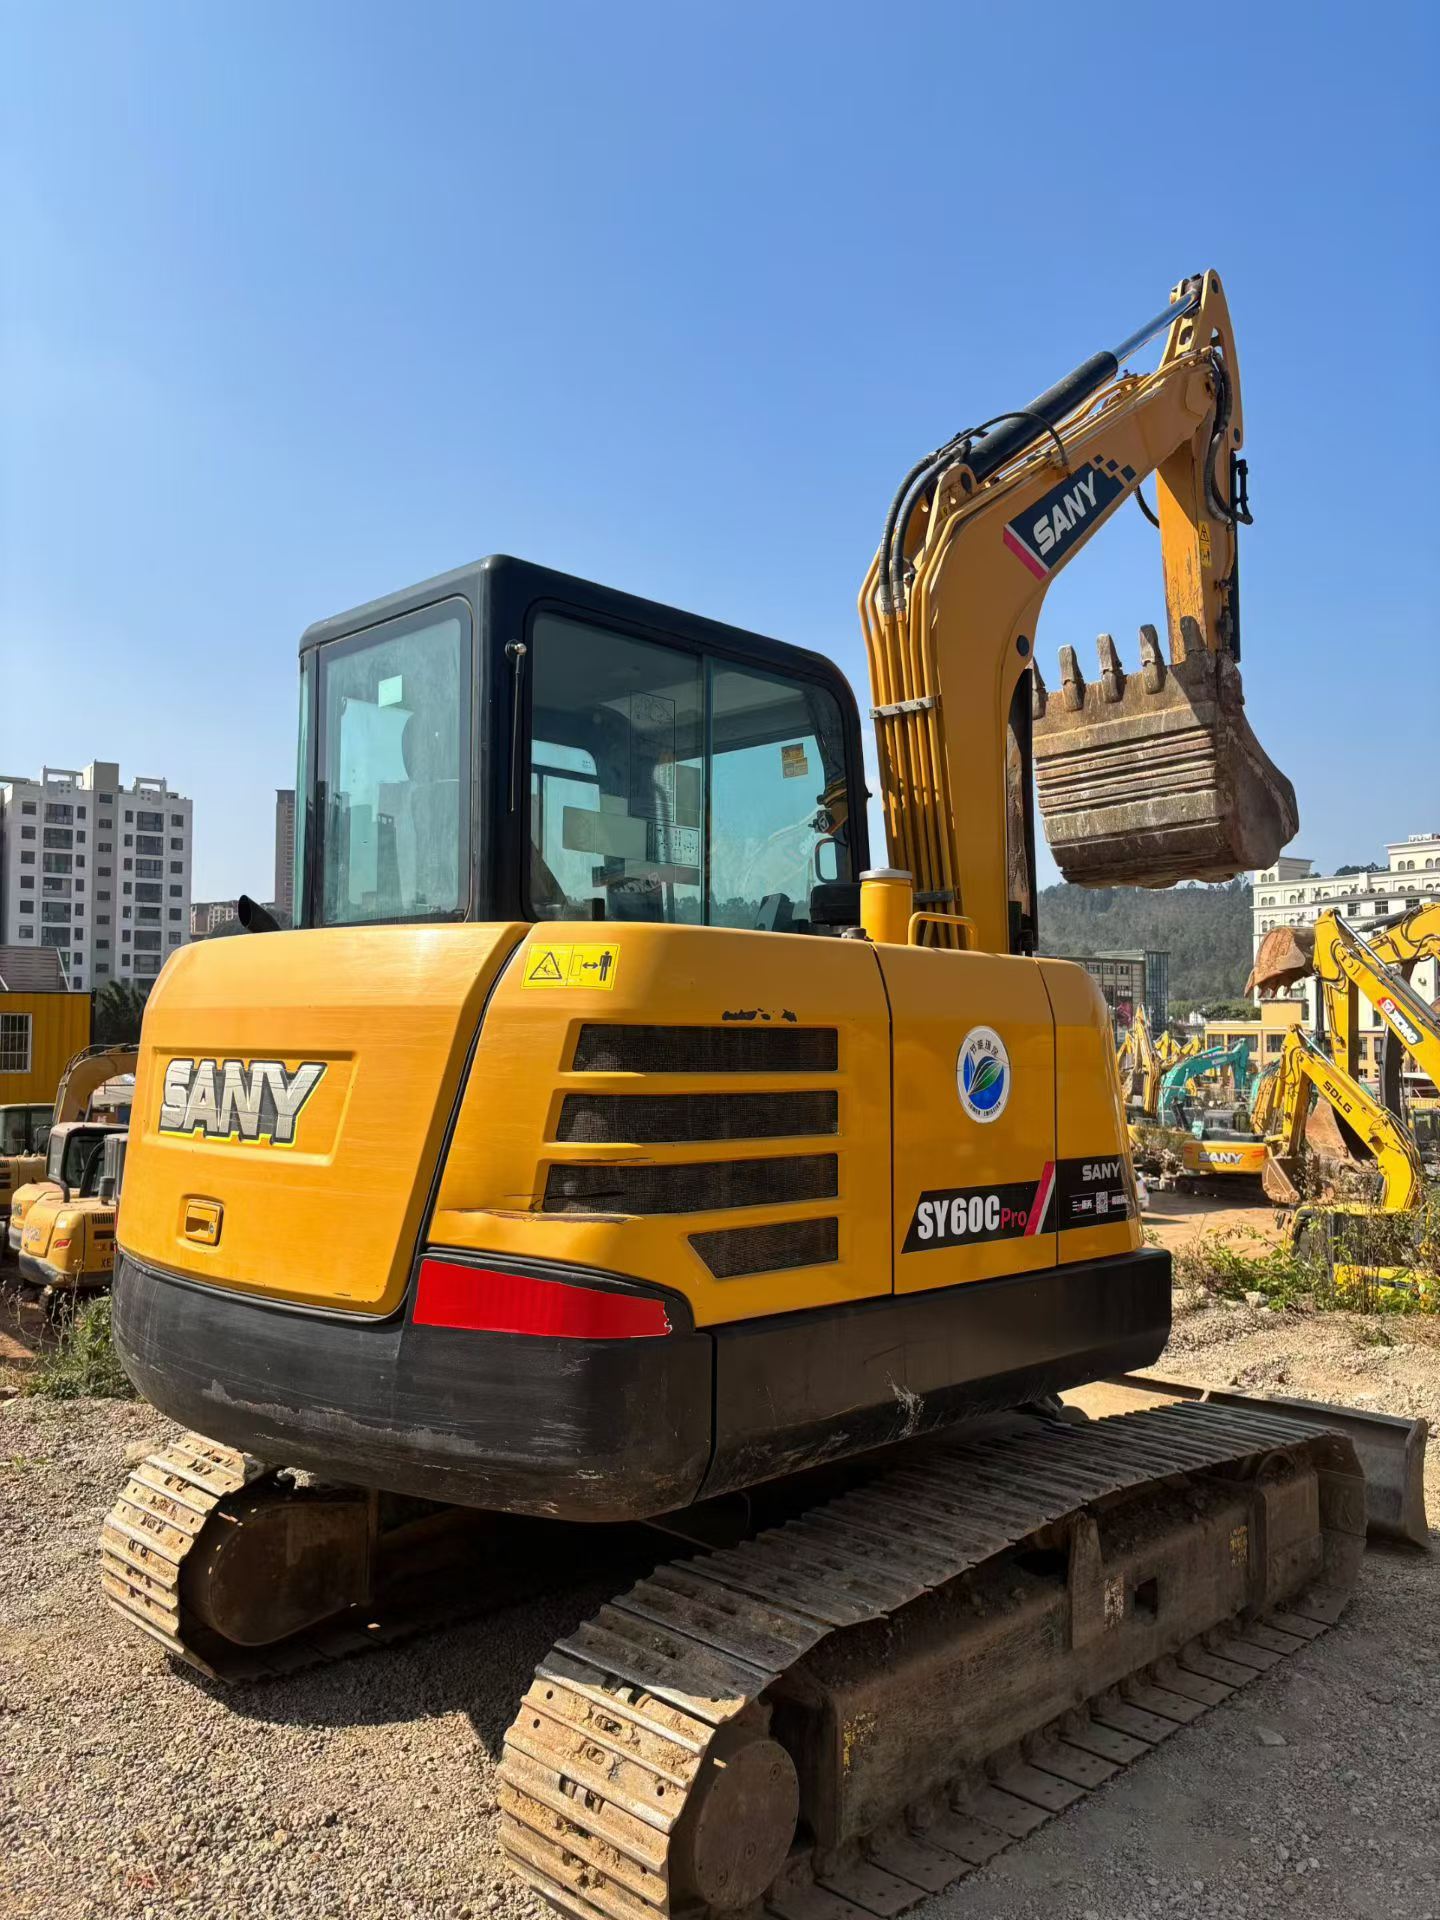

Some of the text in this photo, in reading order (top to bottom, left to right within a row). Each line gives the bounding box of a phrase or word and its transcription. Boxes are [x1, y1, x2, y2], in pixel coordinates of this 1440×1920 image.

[1033, 471, 1097, 556] SANY
[160, 1058, 327, 1143] SANY
[1322, 1080, 1353, 1114] SDLG
[1082, 1162, 1120, 1181] SANY
[1199, 1151, 1245, 1164] SANY
[917, 1194, 1027, 1240] SY60C Pro
